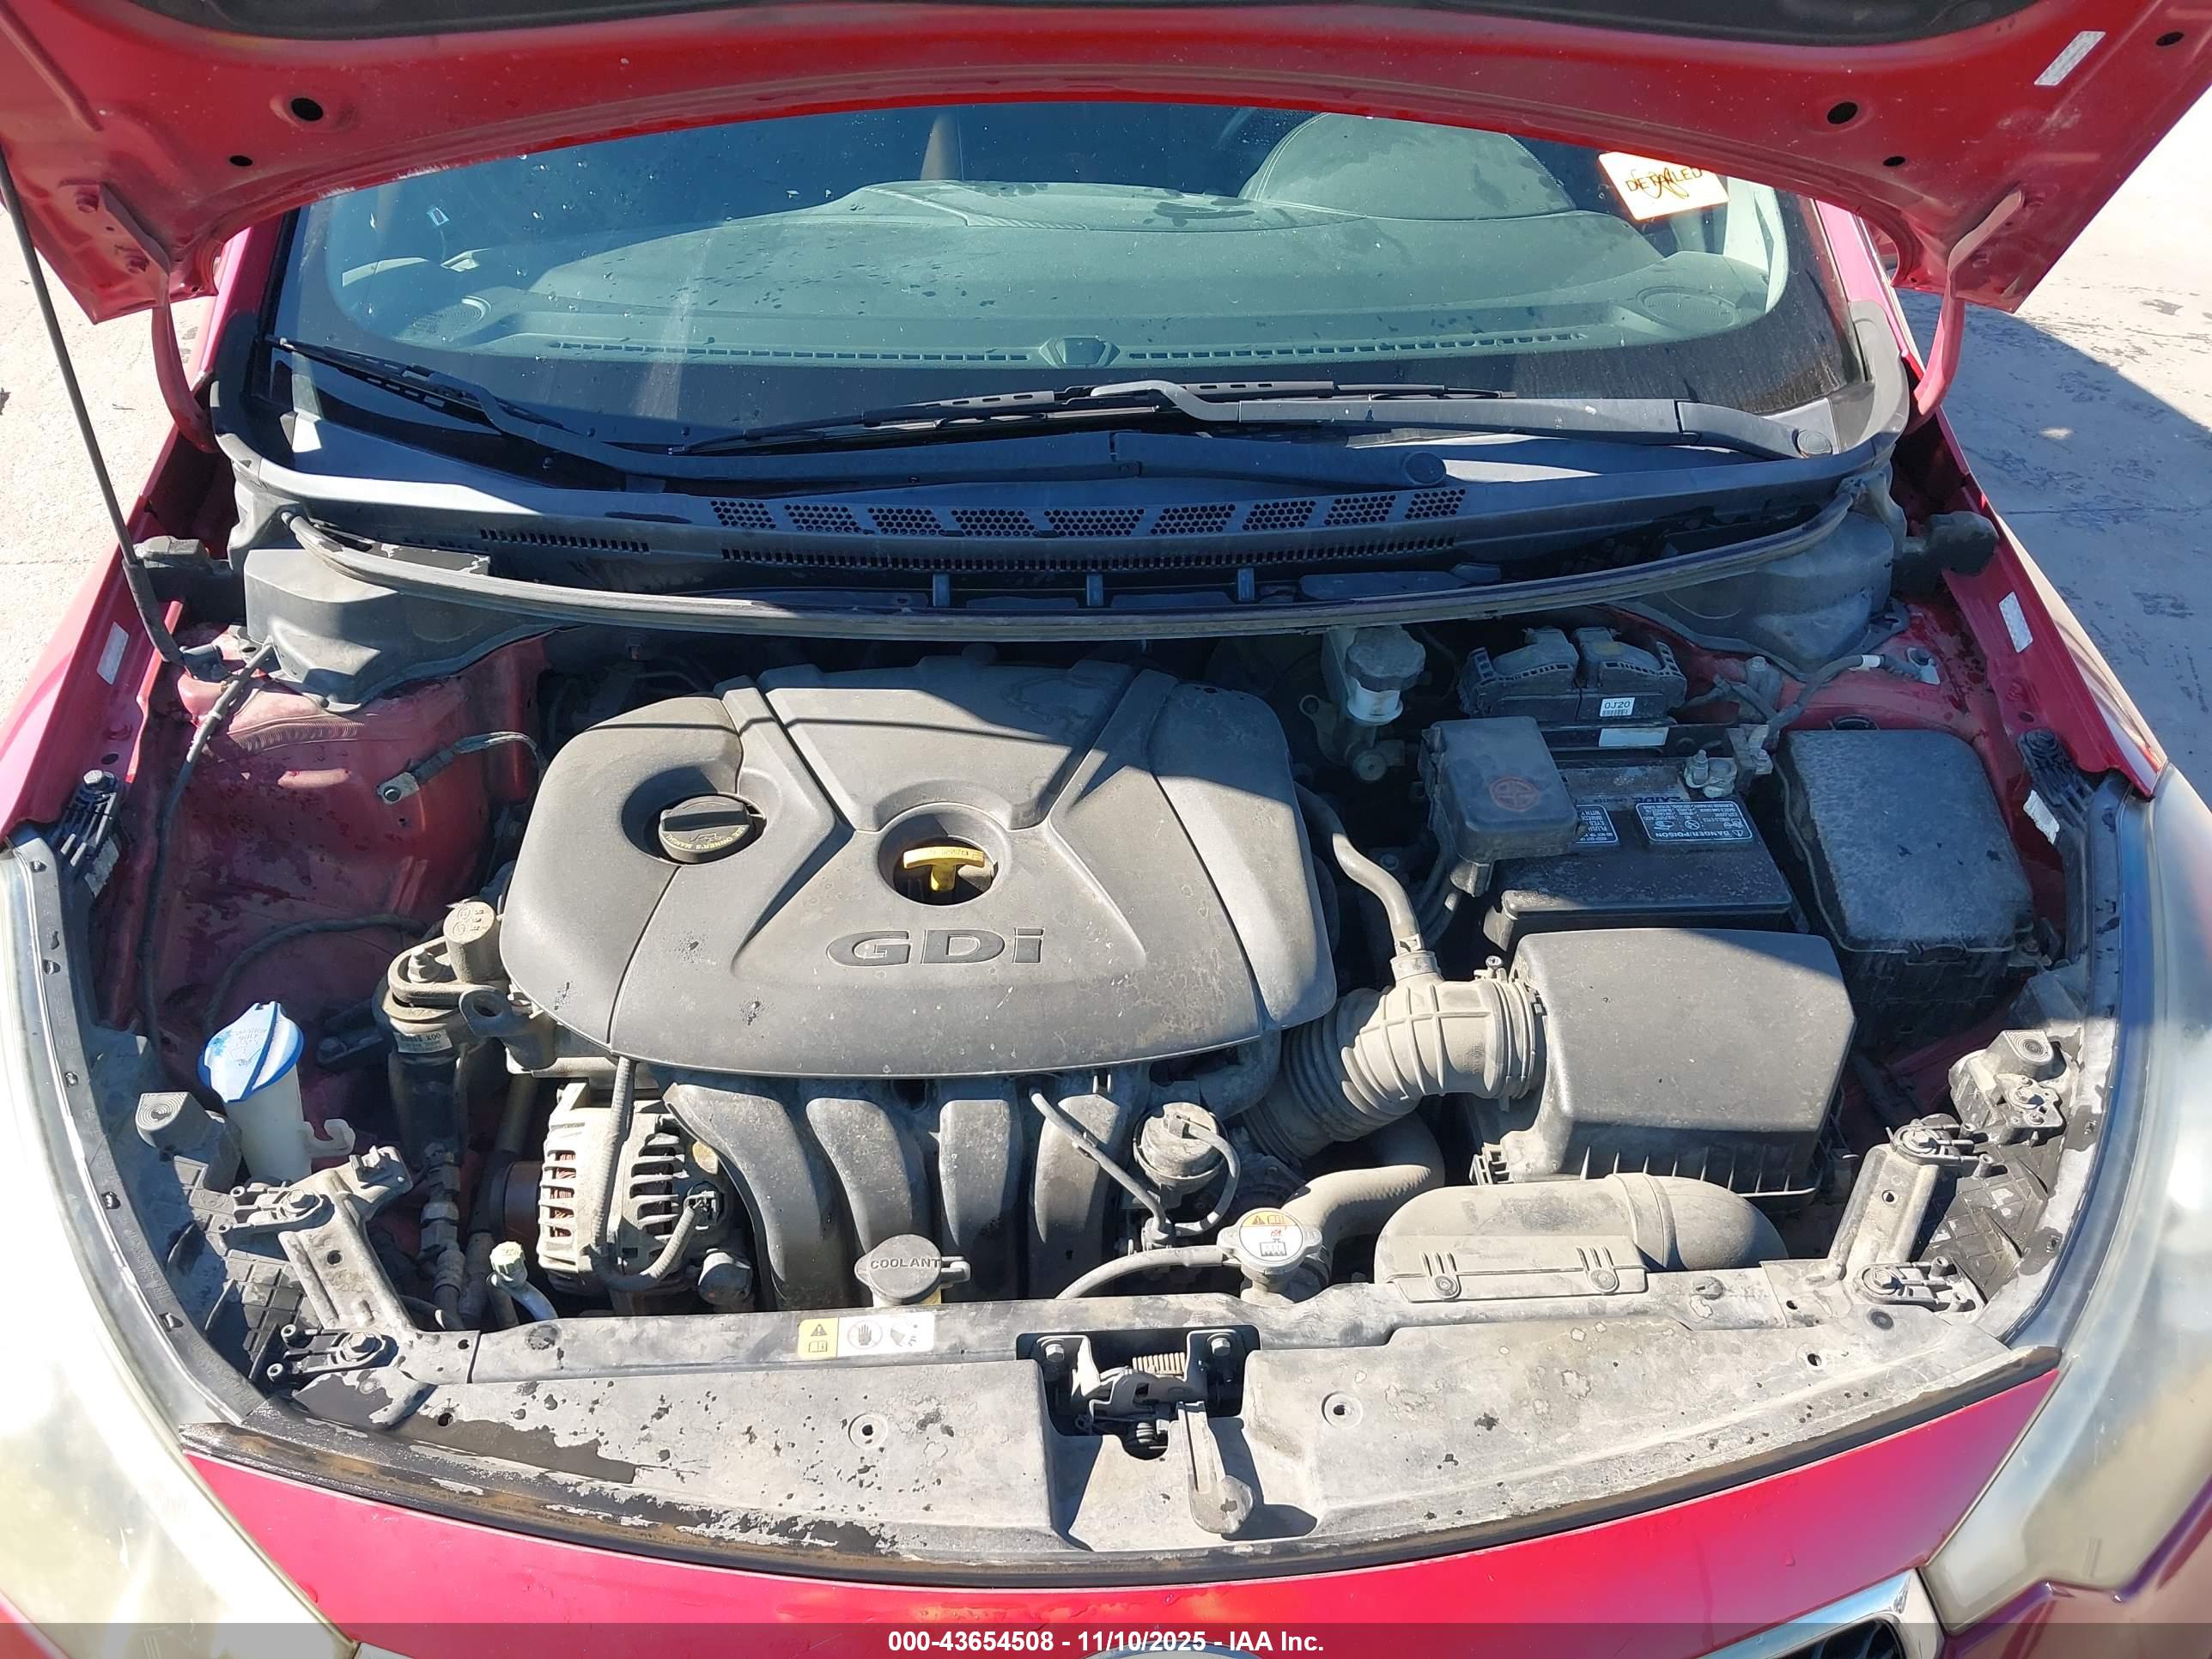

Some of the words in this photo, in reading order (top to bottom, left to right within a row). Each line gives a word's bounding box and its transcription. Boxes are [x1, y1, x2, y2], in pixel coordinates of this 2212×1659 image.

[1626, 167, 1703, 191] DETAILED
[825, 927, 1044, 967] GDi
[870, 1257, 941, 1270] COOLANT
